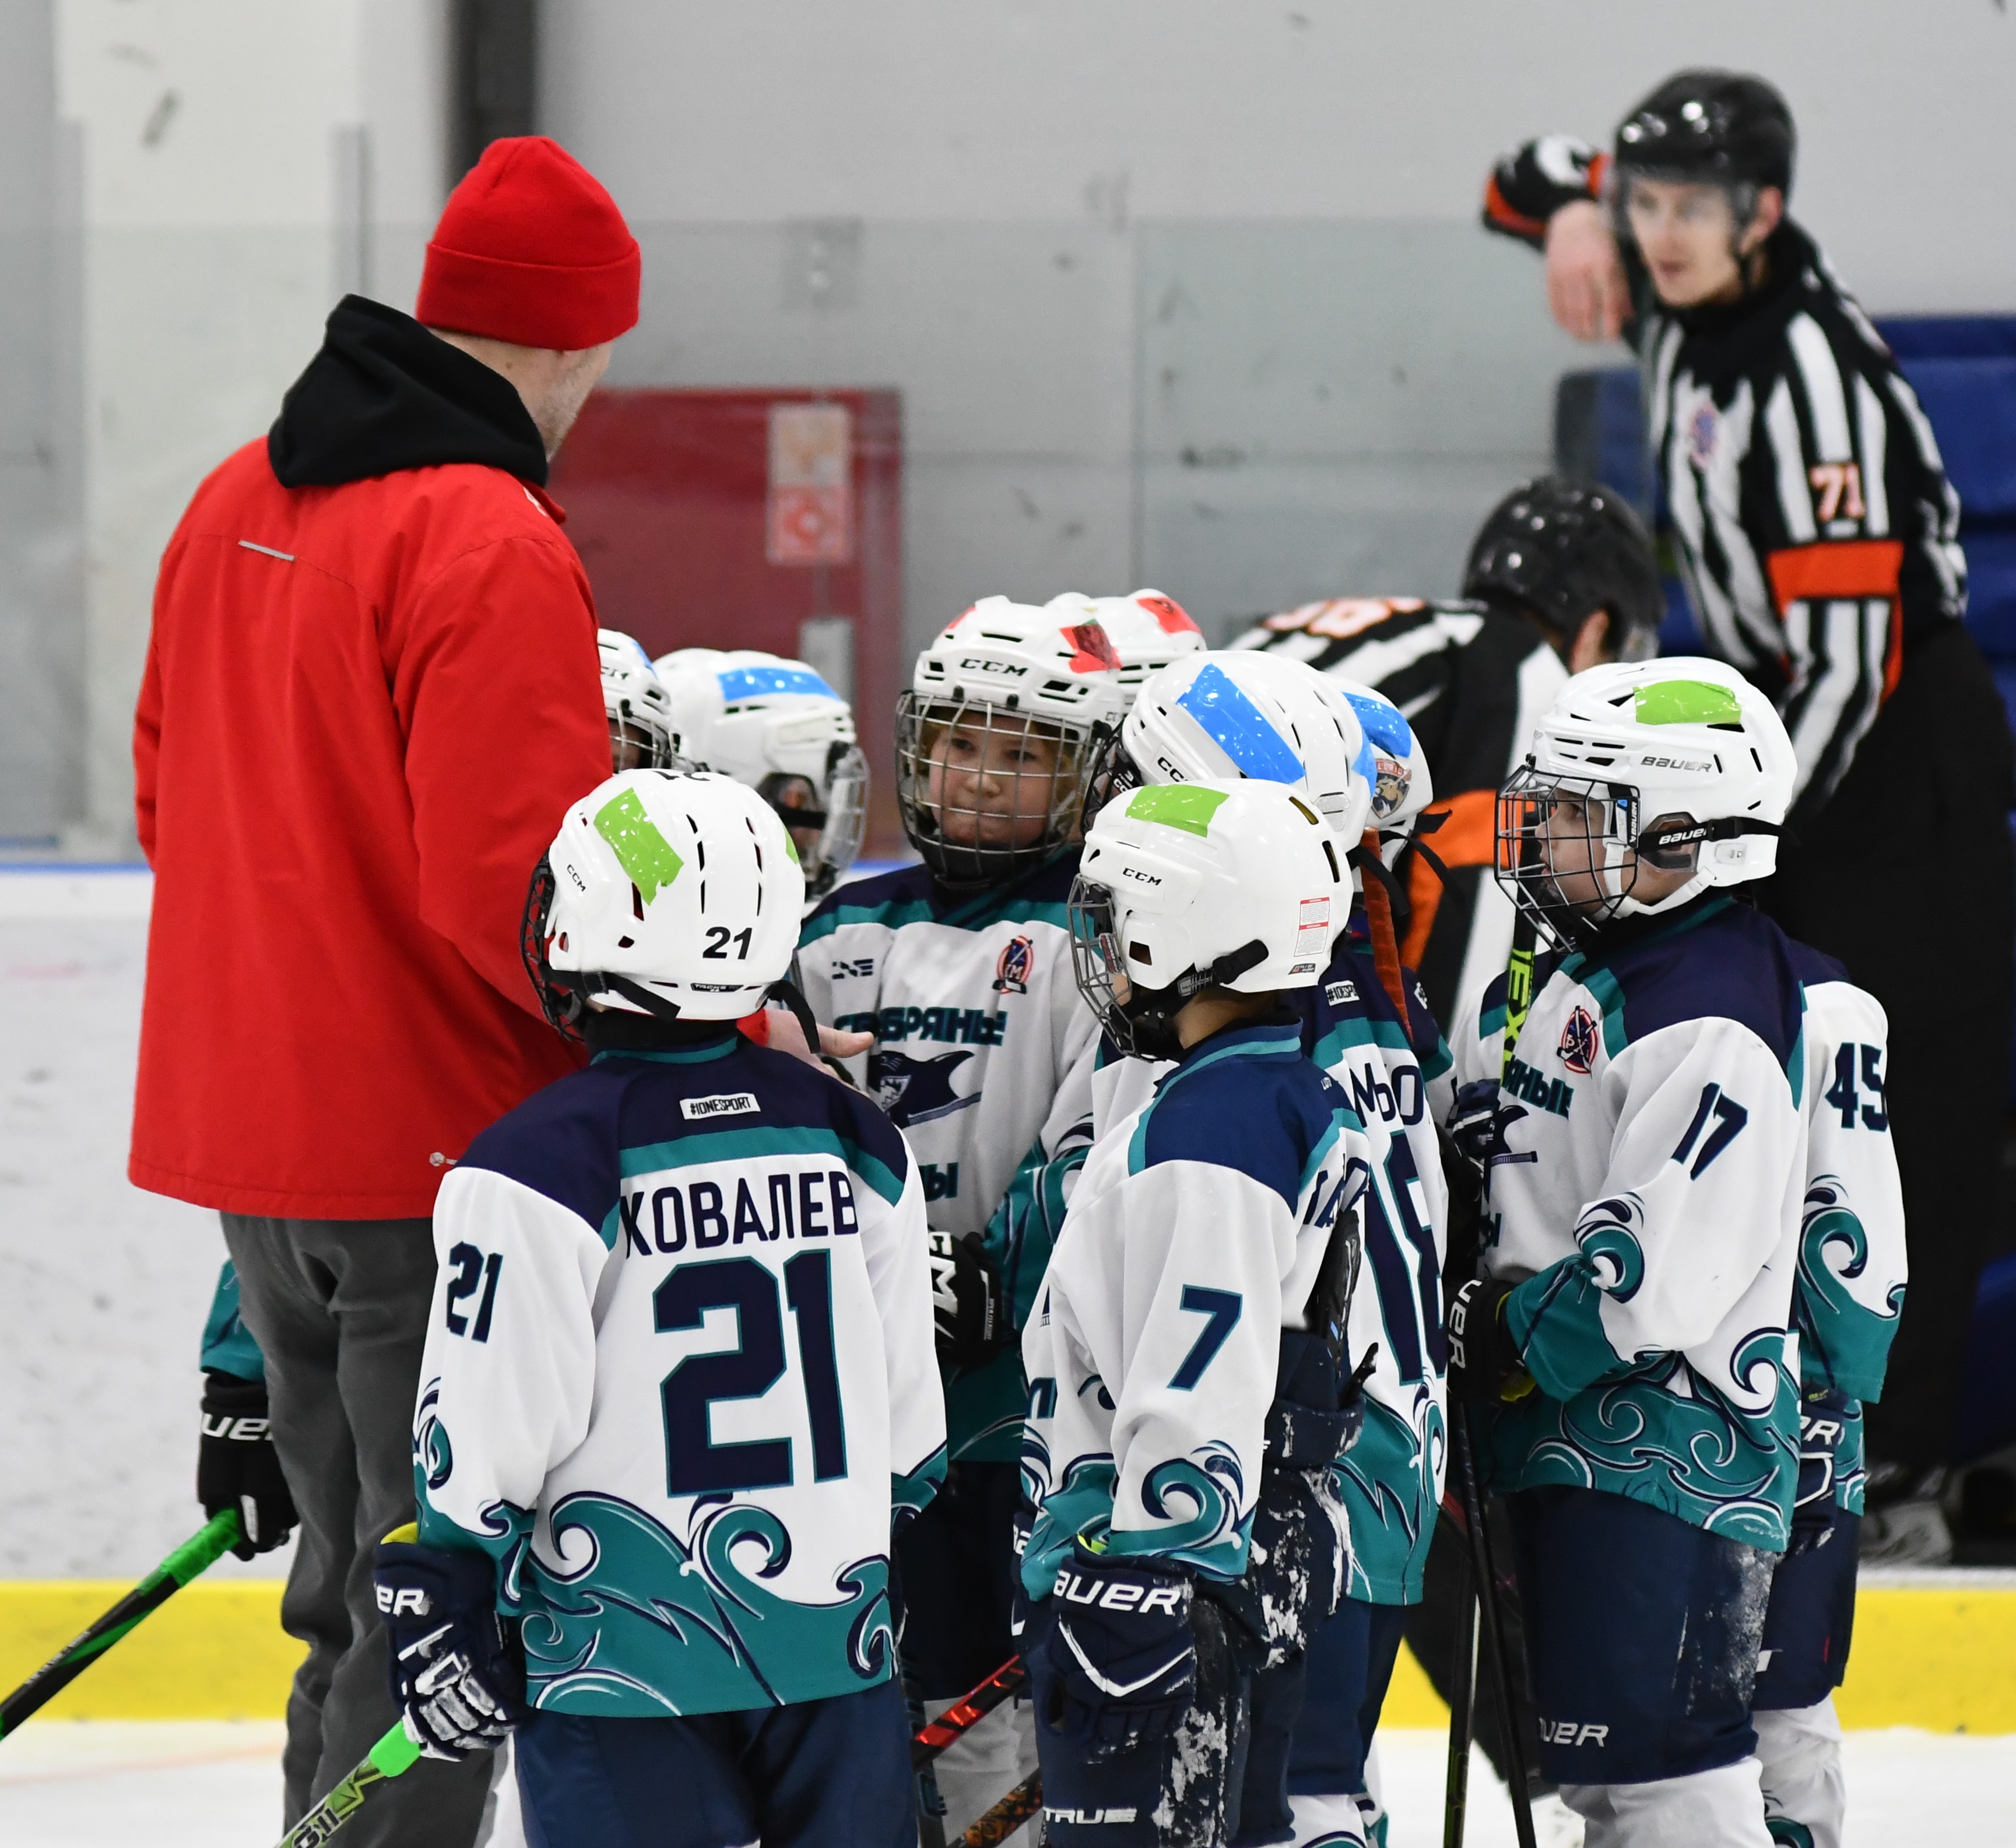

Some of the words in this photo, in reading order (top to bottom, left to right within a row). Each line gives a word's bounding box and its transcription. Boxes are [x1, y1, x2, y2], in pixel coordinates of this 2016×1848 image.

[1810, 462, 1864, 523] 71
[960, 658, 1028, 676] CCM
[1641, 756, 1712, 773] BAUER
[567, 864, 586, 892] CCM
[1122, 867, 1162, 886] CCM
[703, 926, 753, 960] 21
[1825, 1042, 1888, 1132] 45
[1671, 1082, 1748, 1181] 17
[620, 1172, 859, 1259] КОВАЛЕВ
[447, 1240, 503, 1344] 21
[1167, 1284, 1243, 1391] 7
[652, 1248, 848, 1499] 21
[202, 1412, 274, 1441] UE
[374, 1582, 424, 1616] ER
